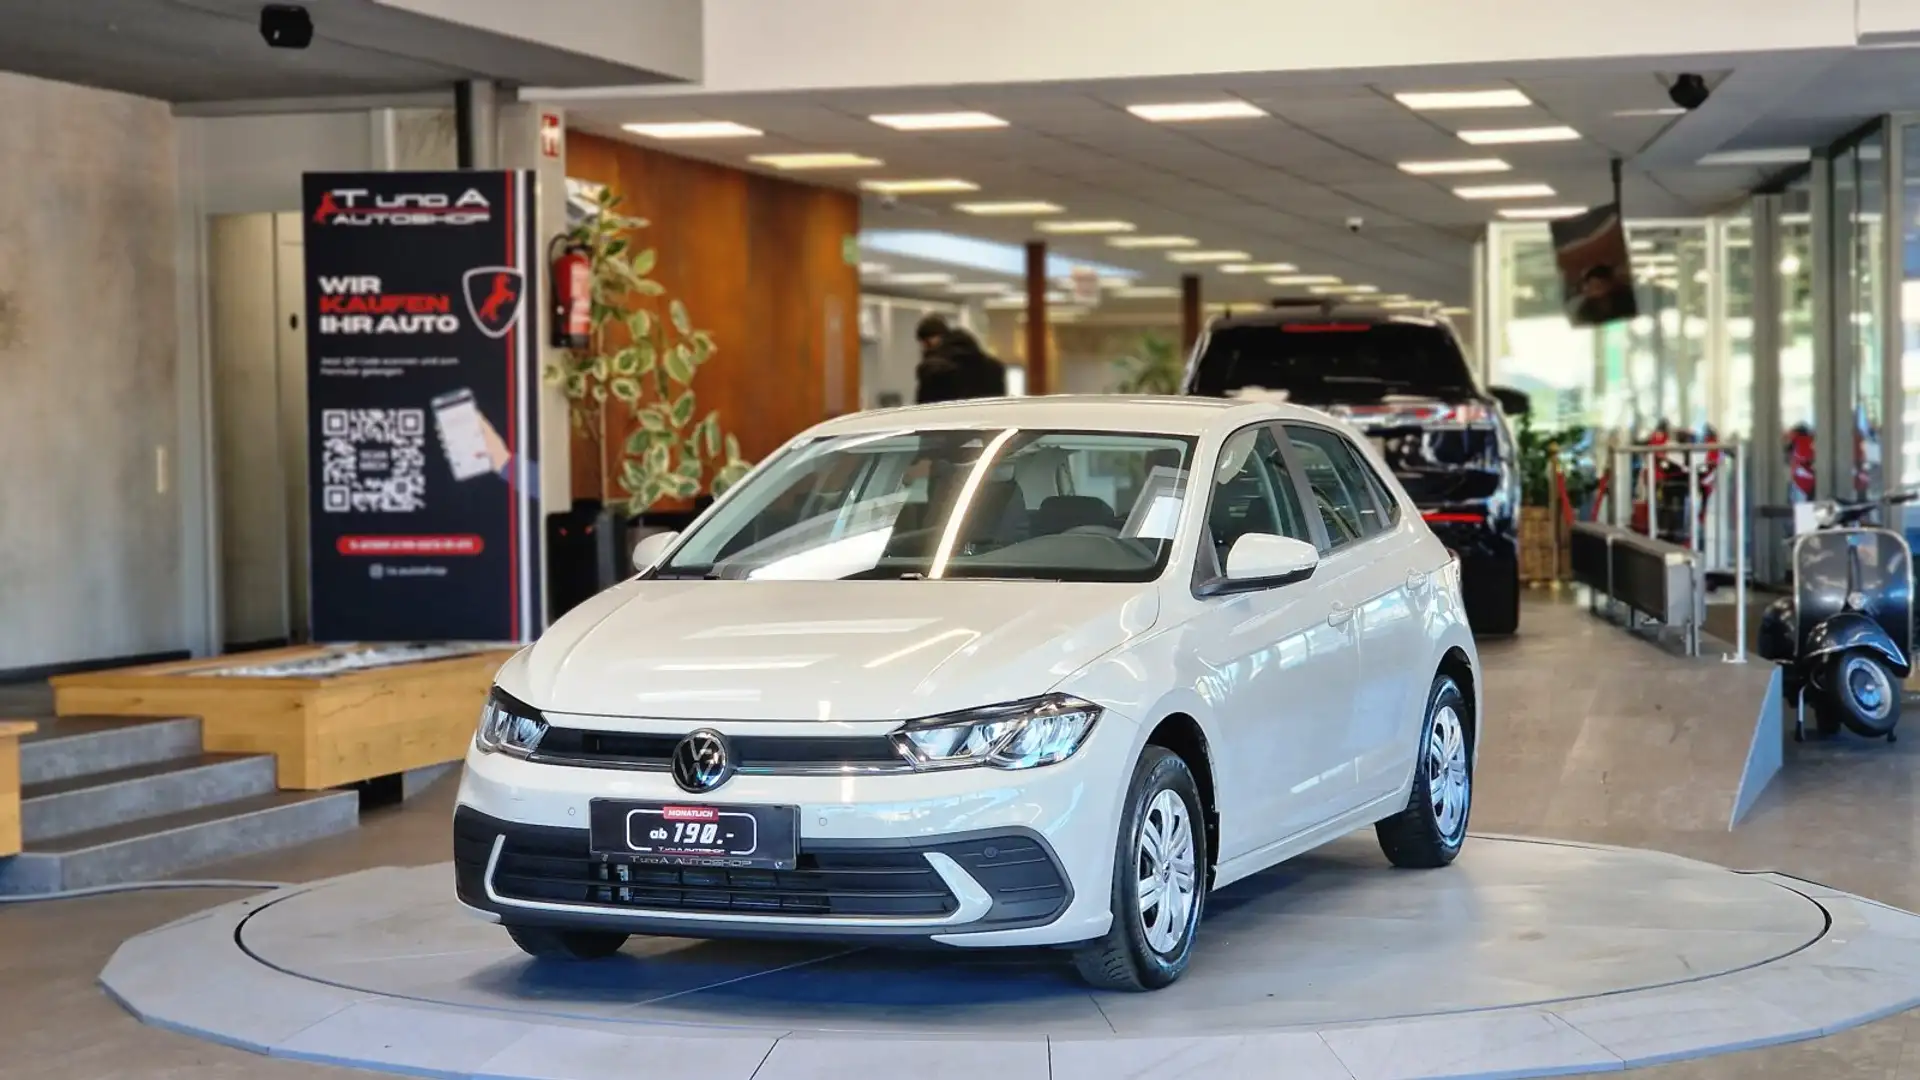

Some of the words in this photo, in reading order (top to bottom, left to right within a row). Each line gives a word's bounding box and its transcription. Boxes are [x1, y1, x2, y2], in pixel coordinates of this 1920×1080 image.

[332, 189, 368, 207] T
[455, 188, 490, 207] A
[332, 213, 490, 225] AUTOSHOP
[319, 276, 381, 294] WIR
[320, 296, 449, 312] KAUFEN
[320, 315, 373, 333] IHR
[376, 315, 459, 333] AUTO
[668, 809, 713, 818] MONATLICH
[649, 827, 668, 839] ab
[674, 857, 752, 867] AUTOSHOP
